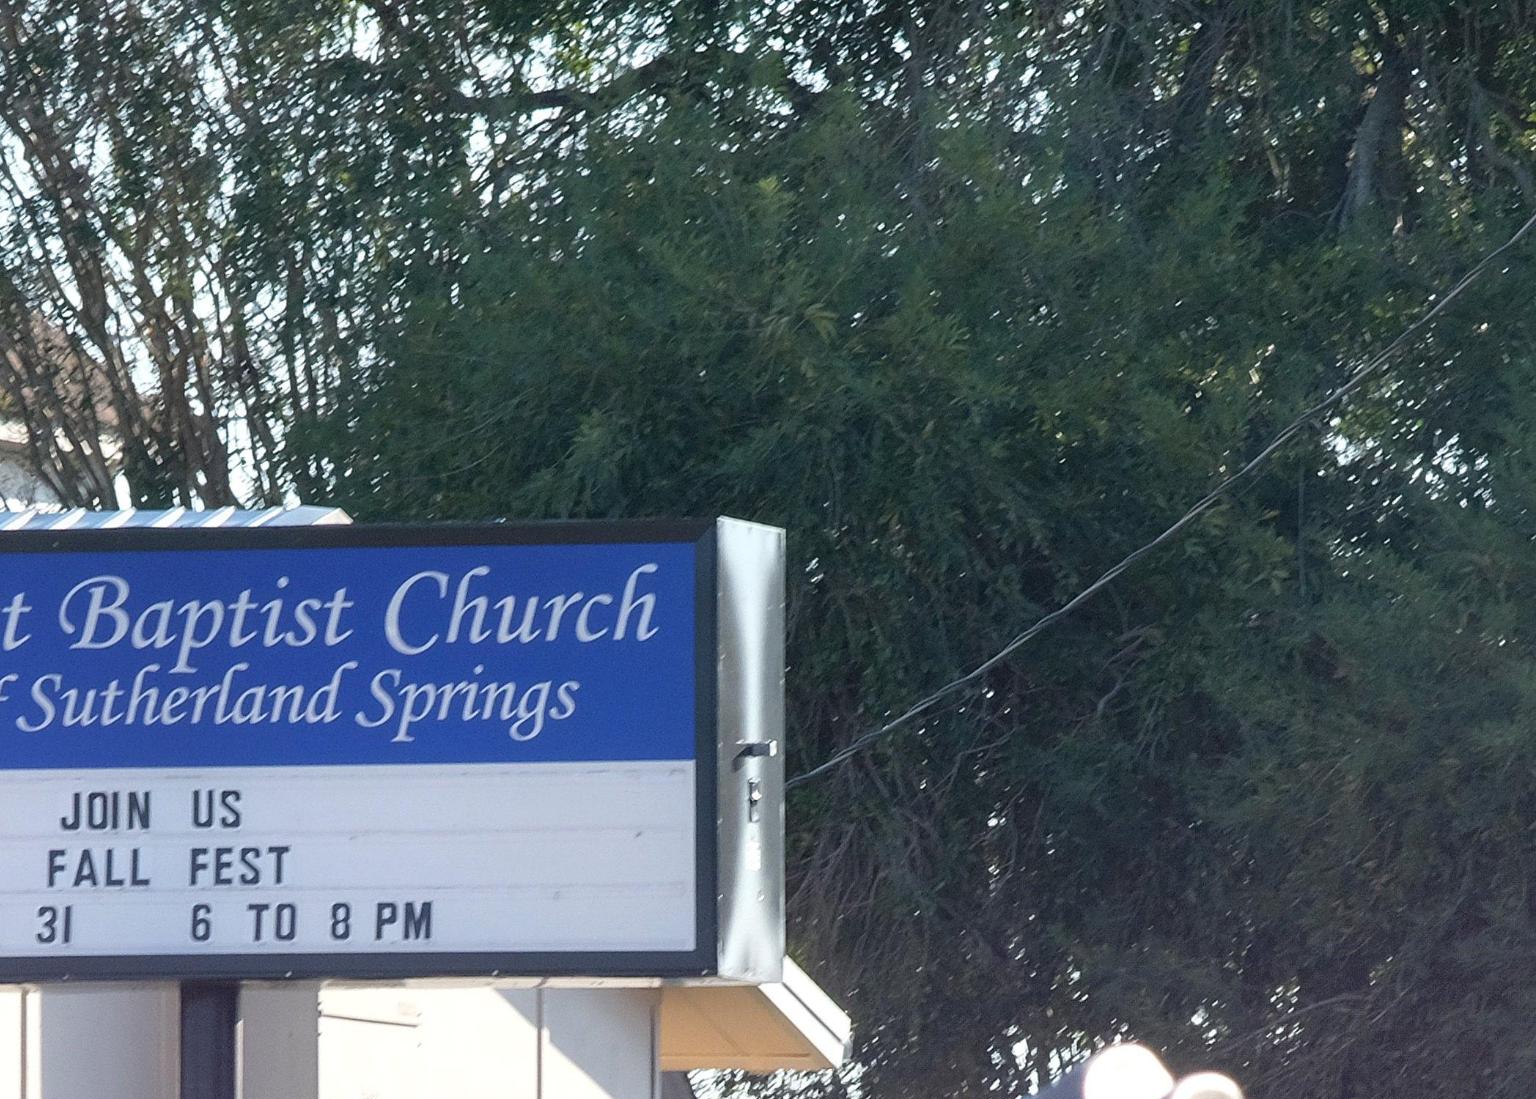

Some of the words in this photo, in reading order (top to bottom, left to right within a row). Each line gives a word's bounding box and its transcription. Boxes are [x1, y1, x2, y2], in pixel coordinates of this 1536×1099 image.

[58, 574, 355, 675] Baptist
[383, 562, 660, 656] Church
[14, 660, 359, 733] Sutherland
[354, 663, 581, 743] Springs
[59, 790, 152, 832] JOIN
[191, 788, 243, 830] US
[46, 847, 152, 889] FALL
[188, 845, 292, 888] FEST
[35, 904, 73, 946] 31
[189, 902, 213, 944] 6
[245, 902, 298, 943] TO
[329, 901, 352, 942] 8
[373, 900, 434, 942] PM
